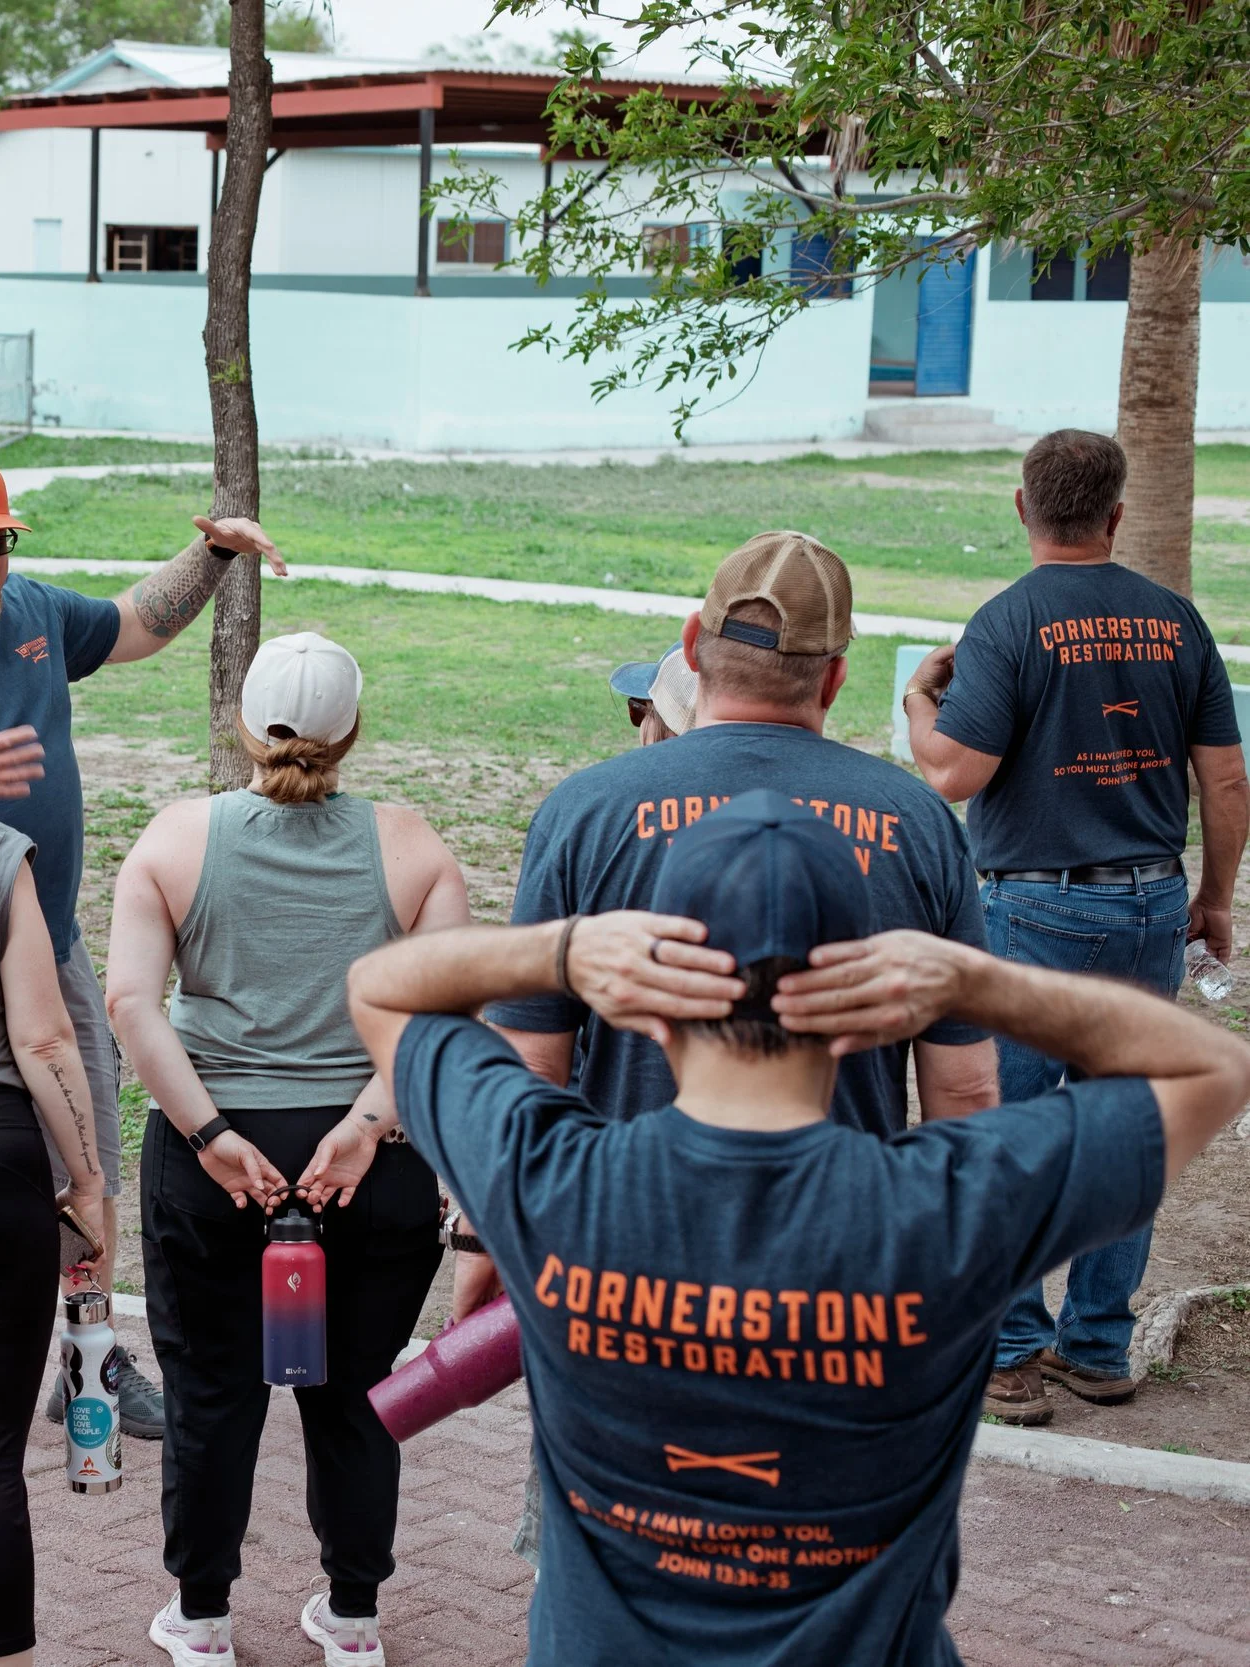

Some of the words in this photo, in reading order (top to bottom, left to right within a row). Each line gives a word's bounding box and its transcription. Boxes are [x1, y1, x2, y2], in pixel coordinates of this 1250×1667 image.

[1039, 616, 1183, 650] CORNERSTONE
[1059, 642, 1174, 664] RESTORATION
[1076, 752, 1088, 761] AS
[1136, 748, 1156, 758] YOU,
[1053, 767, 1066, 777] SO
[1066, 765, 1084, 775] YOU
[1086, 765, 1110, 774] MUST
[1096, 776, 1121, 786] JOHN
[535, 1253, 928, 1347] CORNERSTONE
[567, 1317, 886, 1388] RESTORATION
[72, 1406, 91, 1414] LOVE
[73, 1427, 102, 1435] PEOPLE.
[651, 1510, 703, 1540] HAVE
[706, 1522, 776, 1541] LOVED
[783, 1525, 835, 1544] YOU,
[746, 1543, 790, 1565] ONE
[655, 1551, 711, 1580] JOHN
